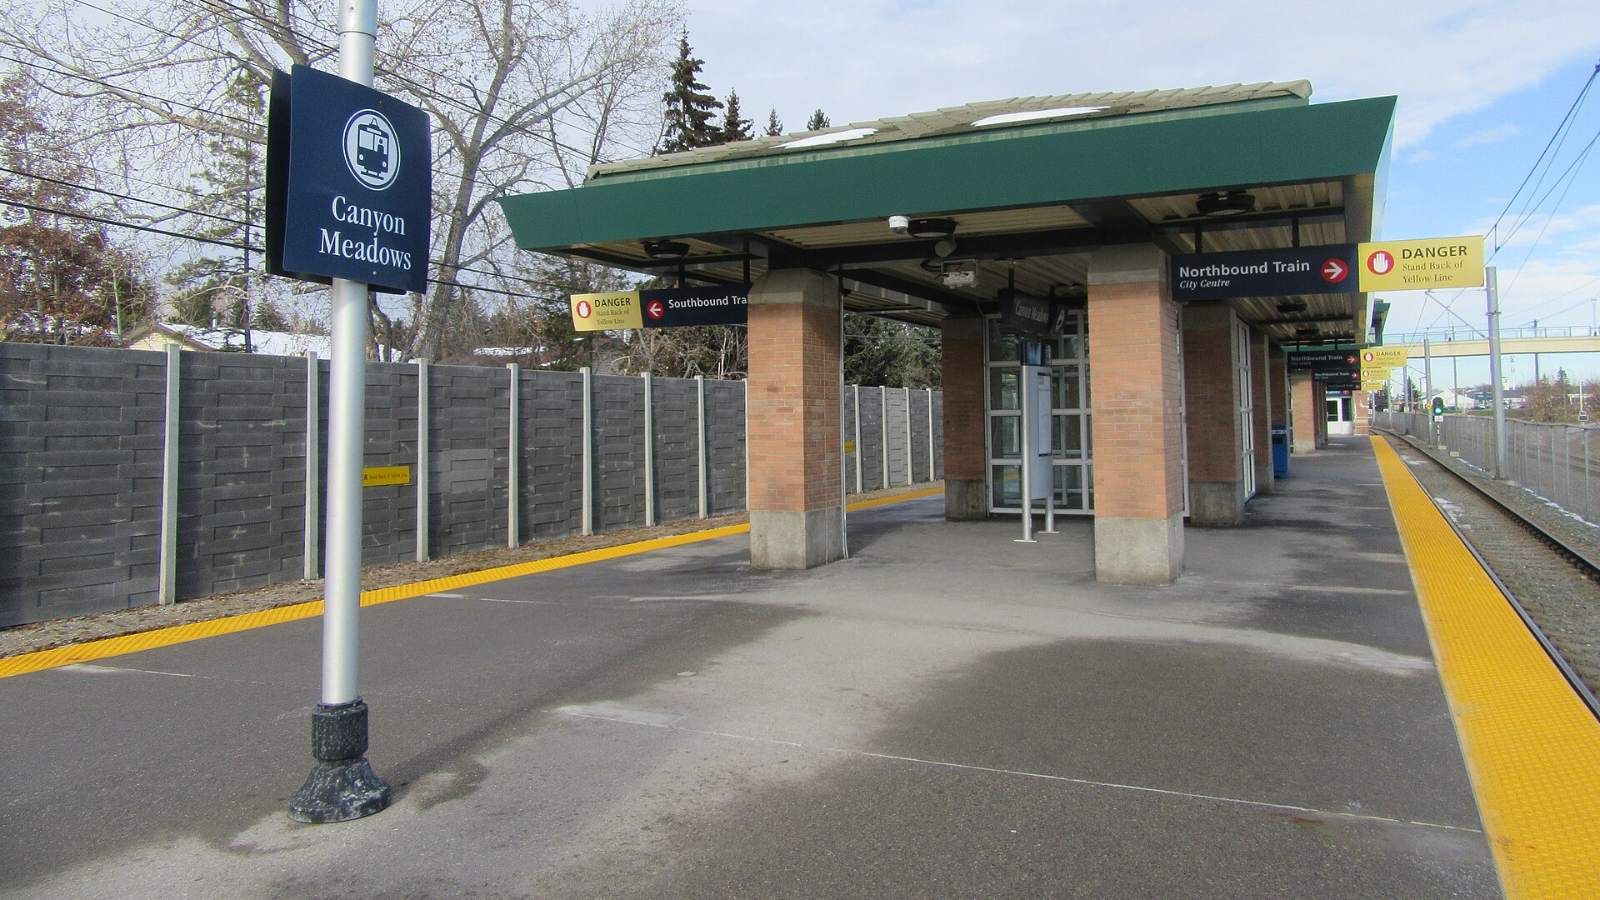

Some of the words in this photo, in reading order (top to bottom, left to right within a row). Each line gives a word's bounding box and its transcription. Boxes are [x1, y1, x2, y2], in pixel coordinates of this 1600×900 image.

[332, 195, 405, 236] Canyon
[319, 228, 411, 270] Meadows
[1402, 245, 1467, 259] DANGER
[1180, 261, 1268, 278] Northbound
[1272, 260, 1310, 273] Train
[1402, 262, 1426, 272] Stand
[1430, 261, 1451, 270] Back
[1454, 260, 1463, 269] of
[1180, 279, 1198, 290] City
[1200, 279, 1230, 288] Centre
[1403, 275, 1432, 283] Yellow
[1434, 273, 1453, 282] Line
[595, 297, 631, 307] DANGER
[668, 295, 729, 309] Southbound
